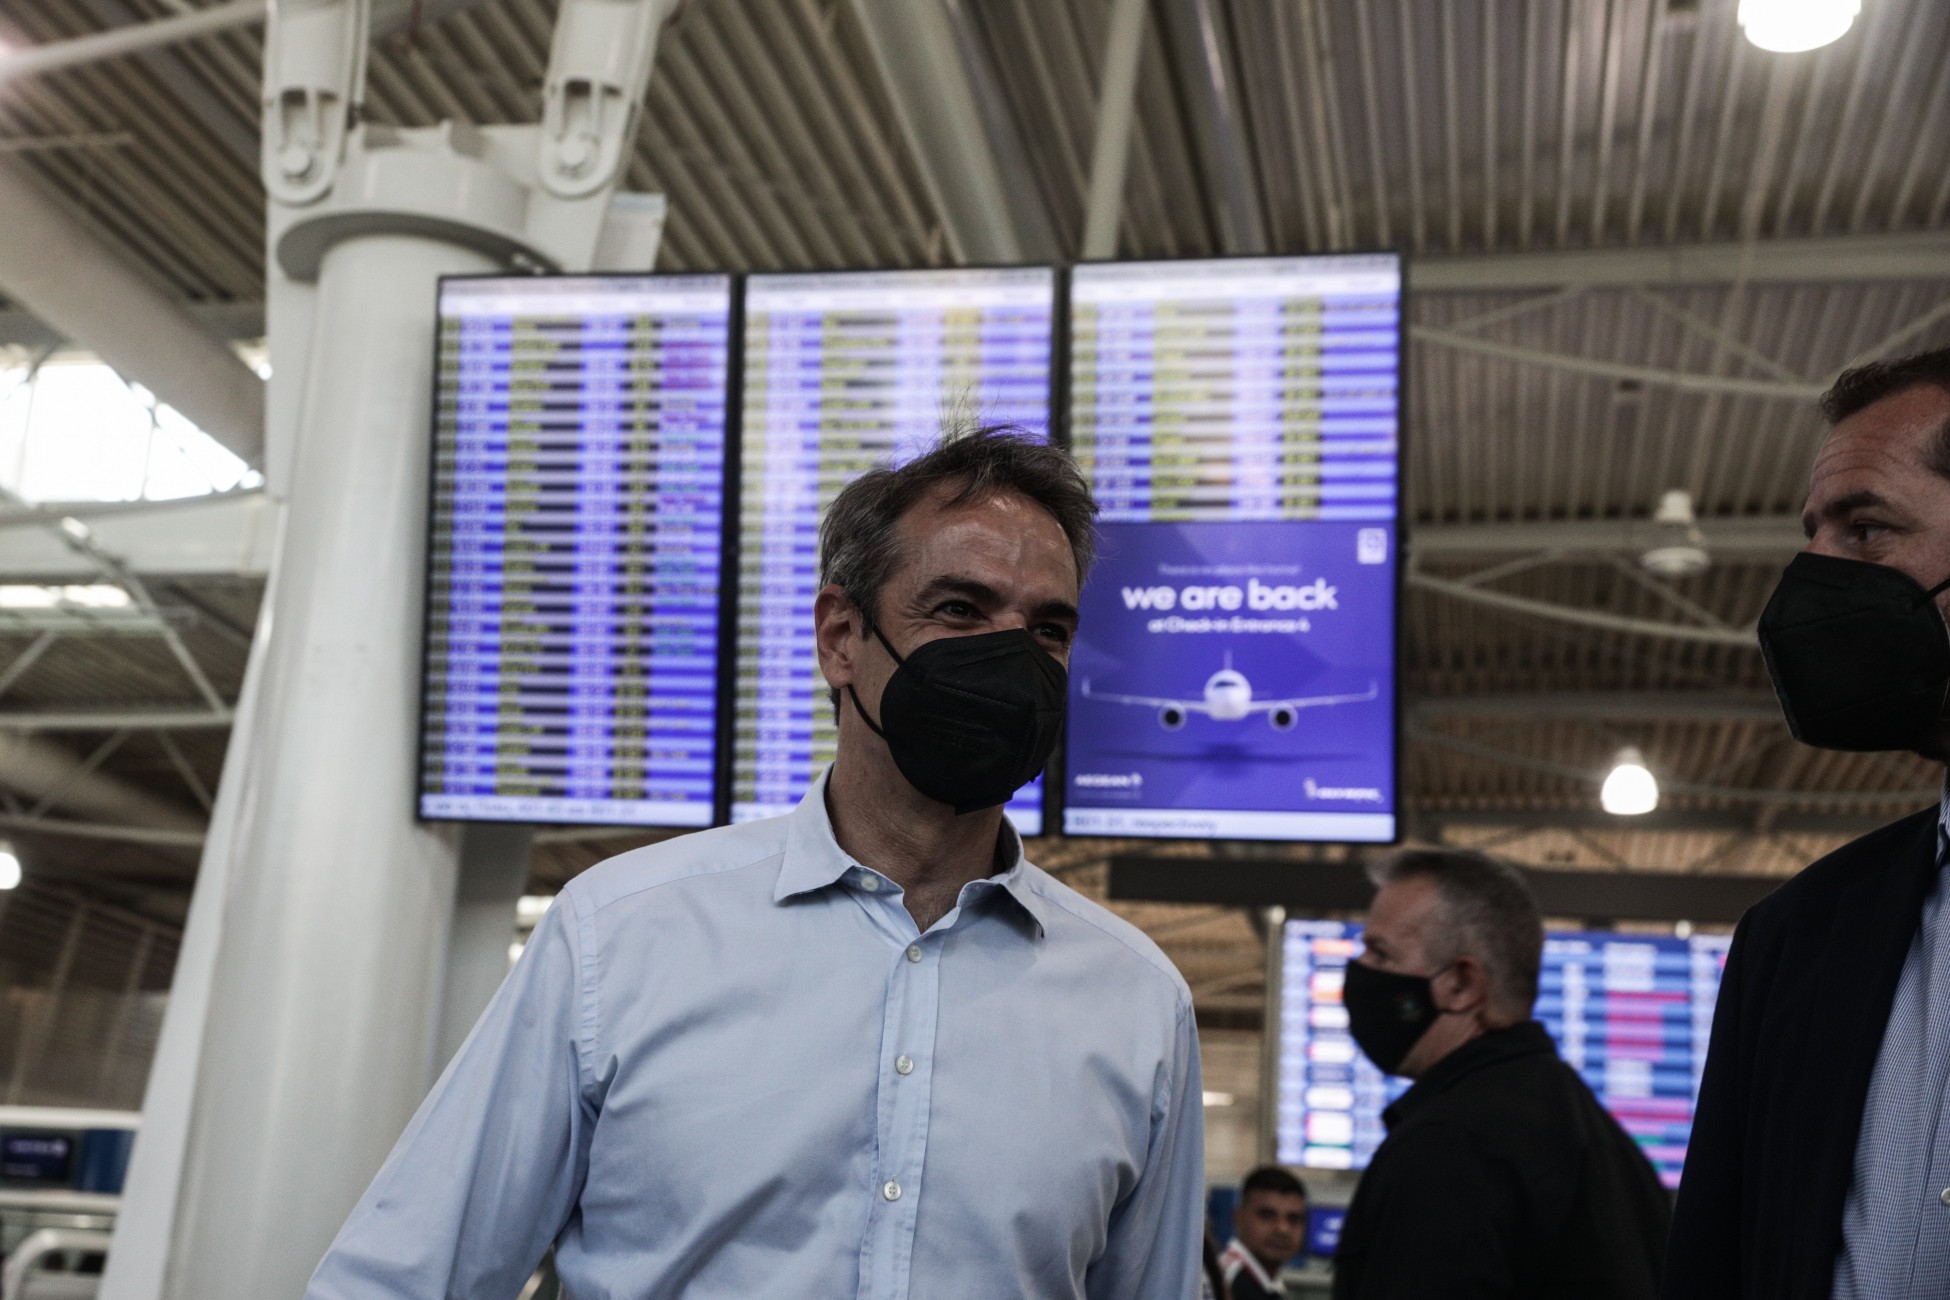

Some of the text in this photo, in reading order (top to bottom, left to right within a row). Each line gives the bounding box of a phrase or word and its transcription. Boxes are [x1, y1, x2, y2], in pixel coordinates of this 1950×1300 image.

[1122, 577, 1339, 611] we are back
